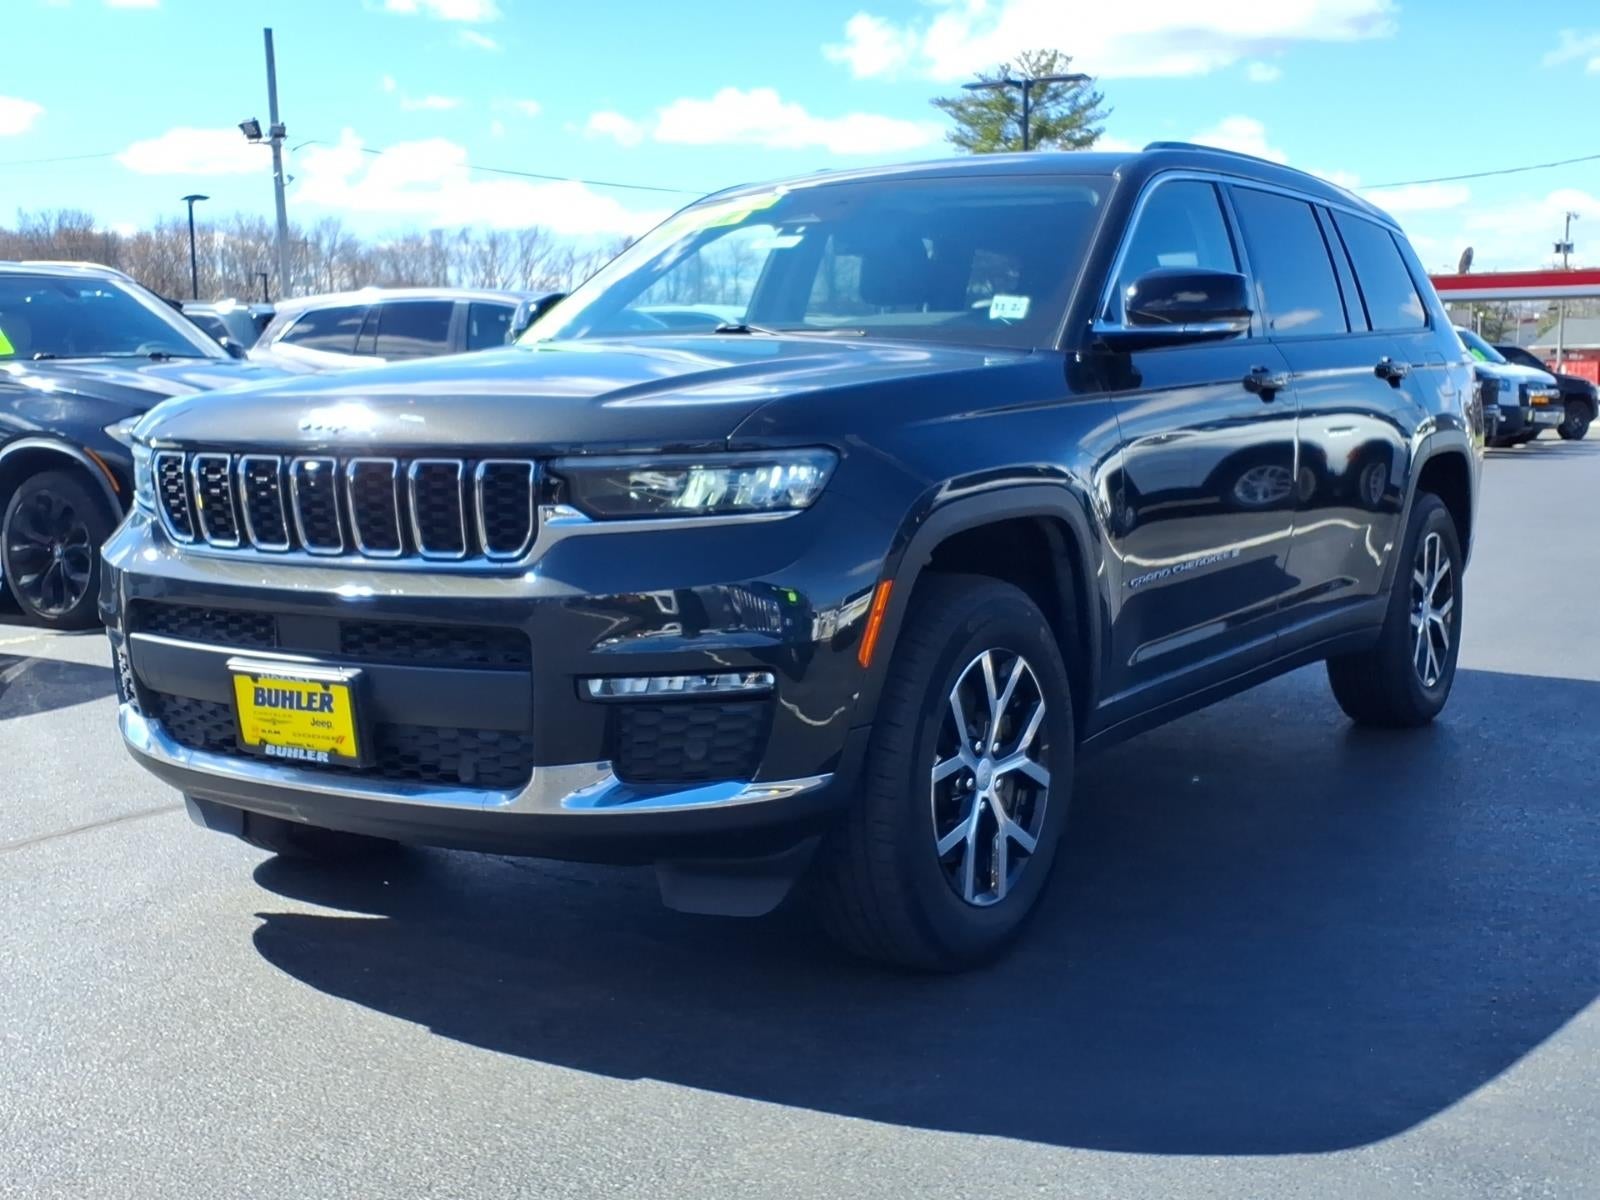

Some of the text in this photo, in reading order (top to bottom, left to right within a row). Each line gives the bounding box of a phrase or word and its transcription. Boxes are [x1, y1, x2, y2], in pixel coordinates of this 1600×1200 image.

[254, 687, 334, 713] BUHLER
[310, 717, 333, 729] Jeep
[265, 745, 329, 762] BUHLER
